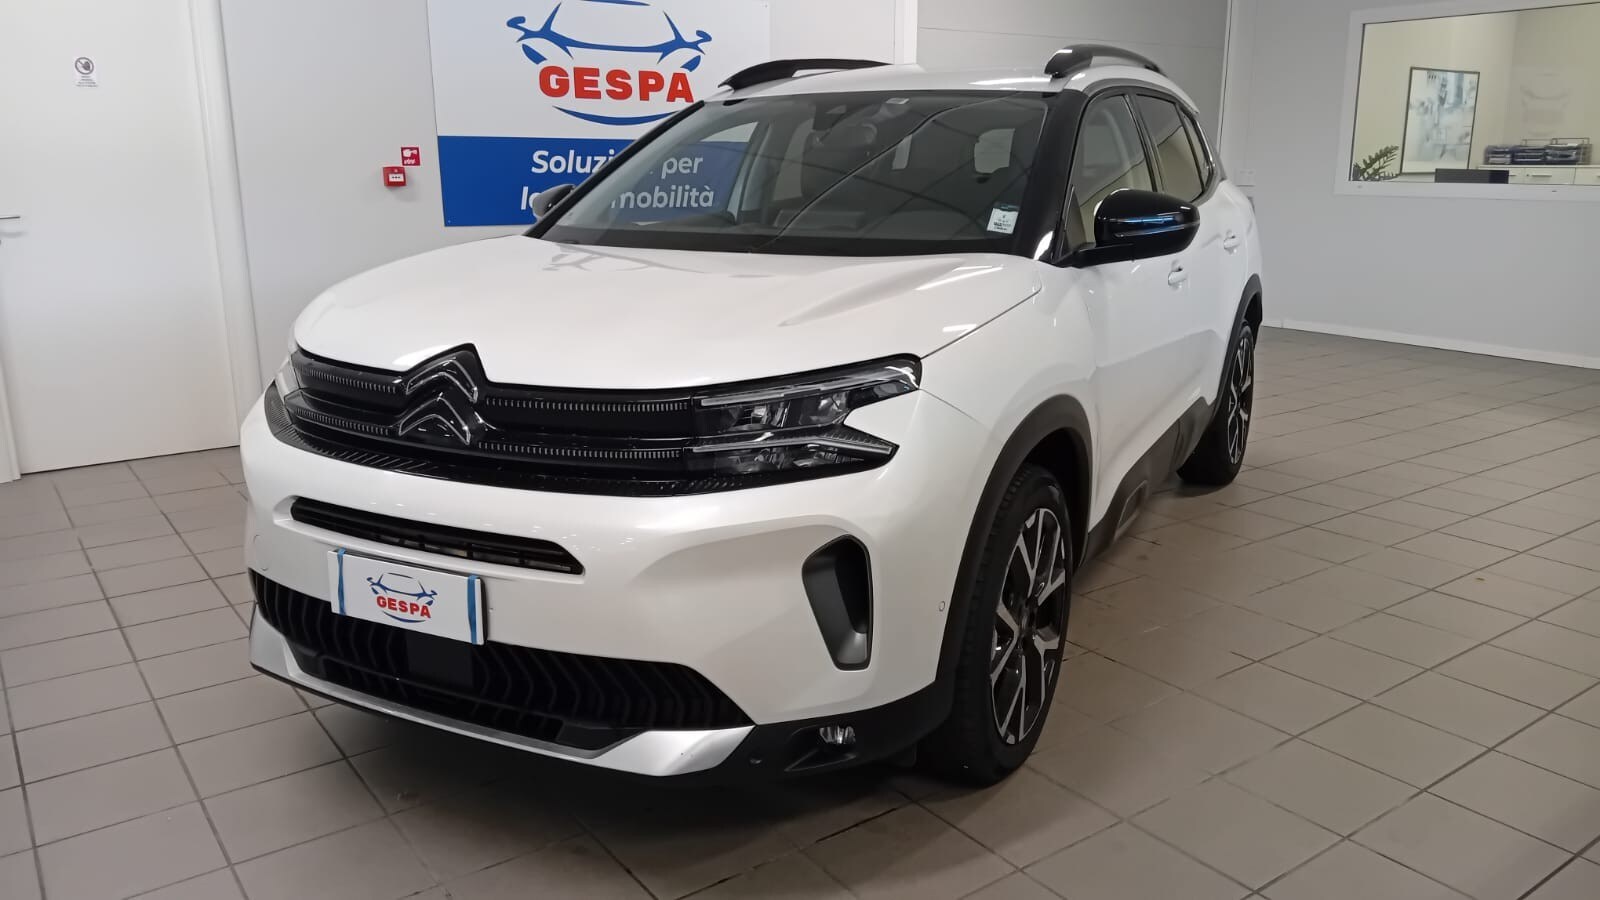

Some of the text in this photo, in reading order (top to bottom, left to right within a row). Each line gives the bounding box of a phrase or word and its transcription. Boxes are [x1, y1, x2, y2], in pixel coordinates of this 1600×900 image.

[538, 65, 695, 104] GESPA
[531, 148, 704, 179] Soluzi per
[376, 595, 431, 619] GESPA
